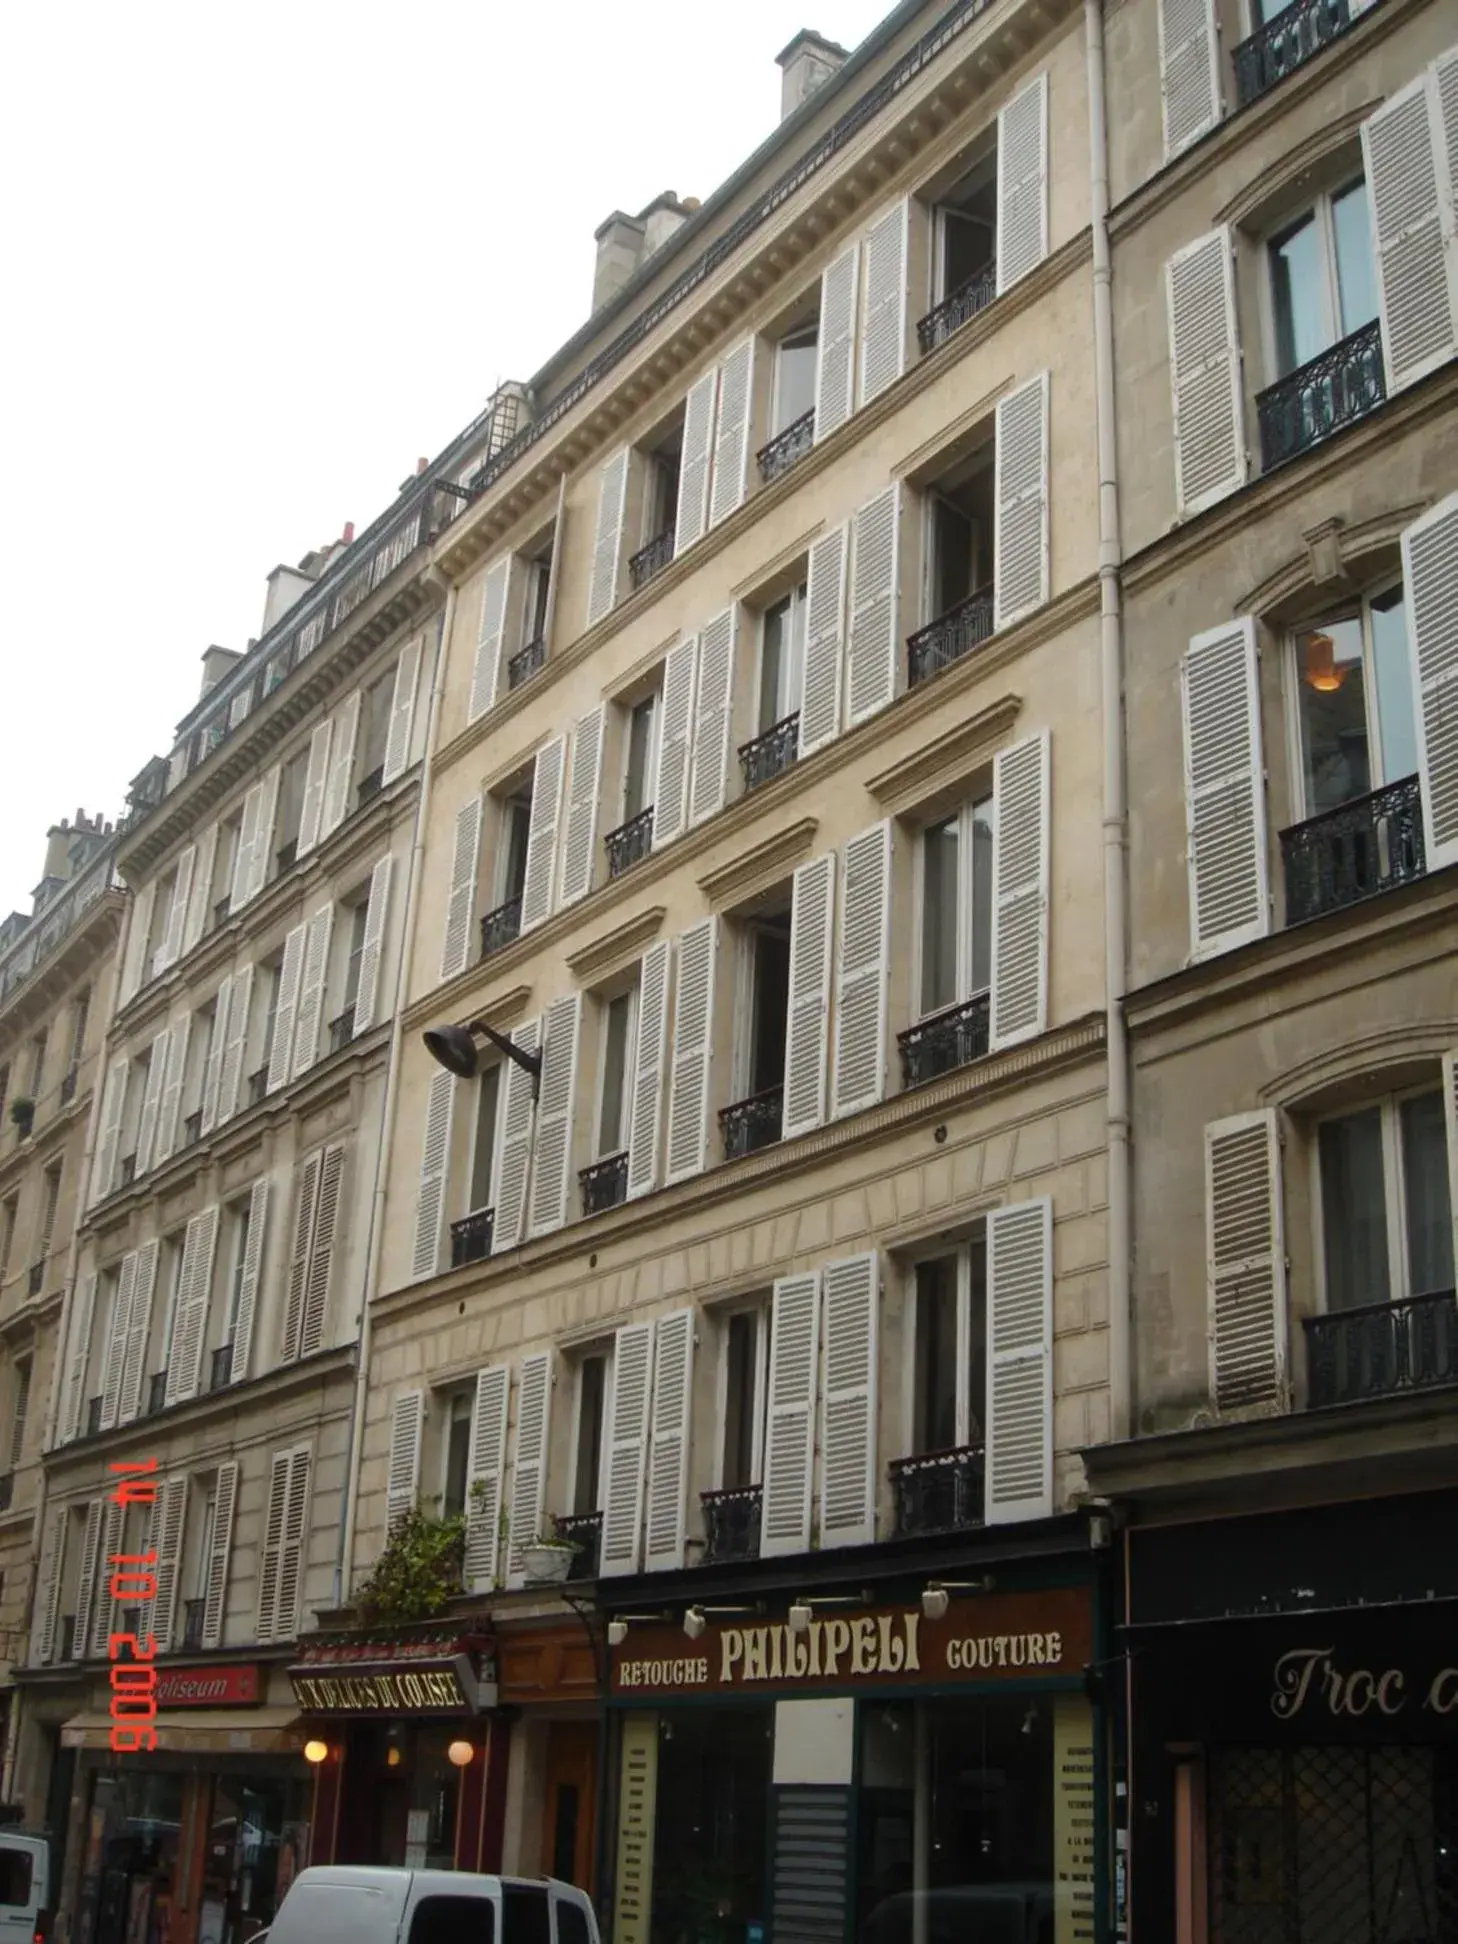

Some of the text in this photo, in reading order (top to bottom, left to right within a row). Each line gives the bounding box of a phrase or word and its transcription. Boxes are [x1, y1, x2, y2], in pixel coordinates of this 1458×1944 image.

[719, 1613, 920, 1682] PHILIPELI
[947, 1632, 1062, 1669] COUTURE
[1270, 1645, 1407, 1719] Troc
